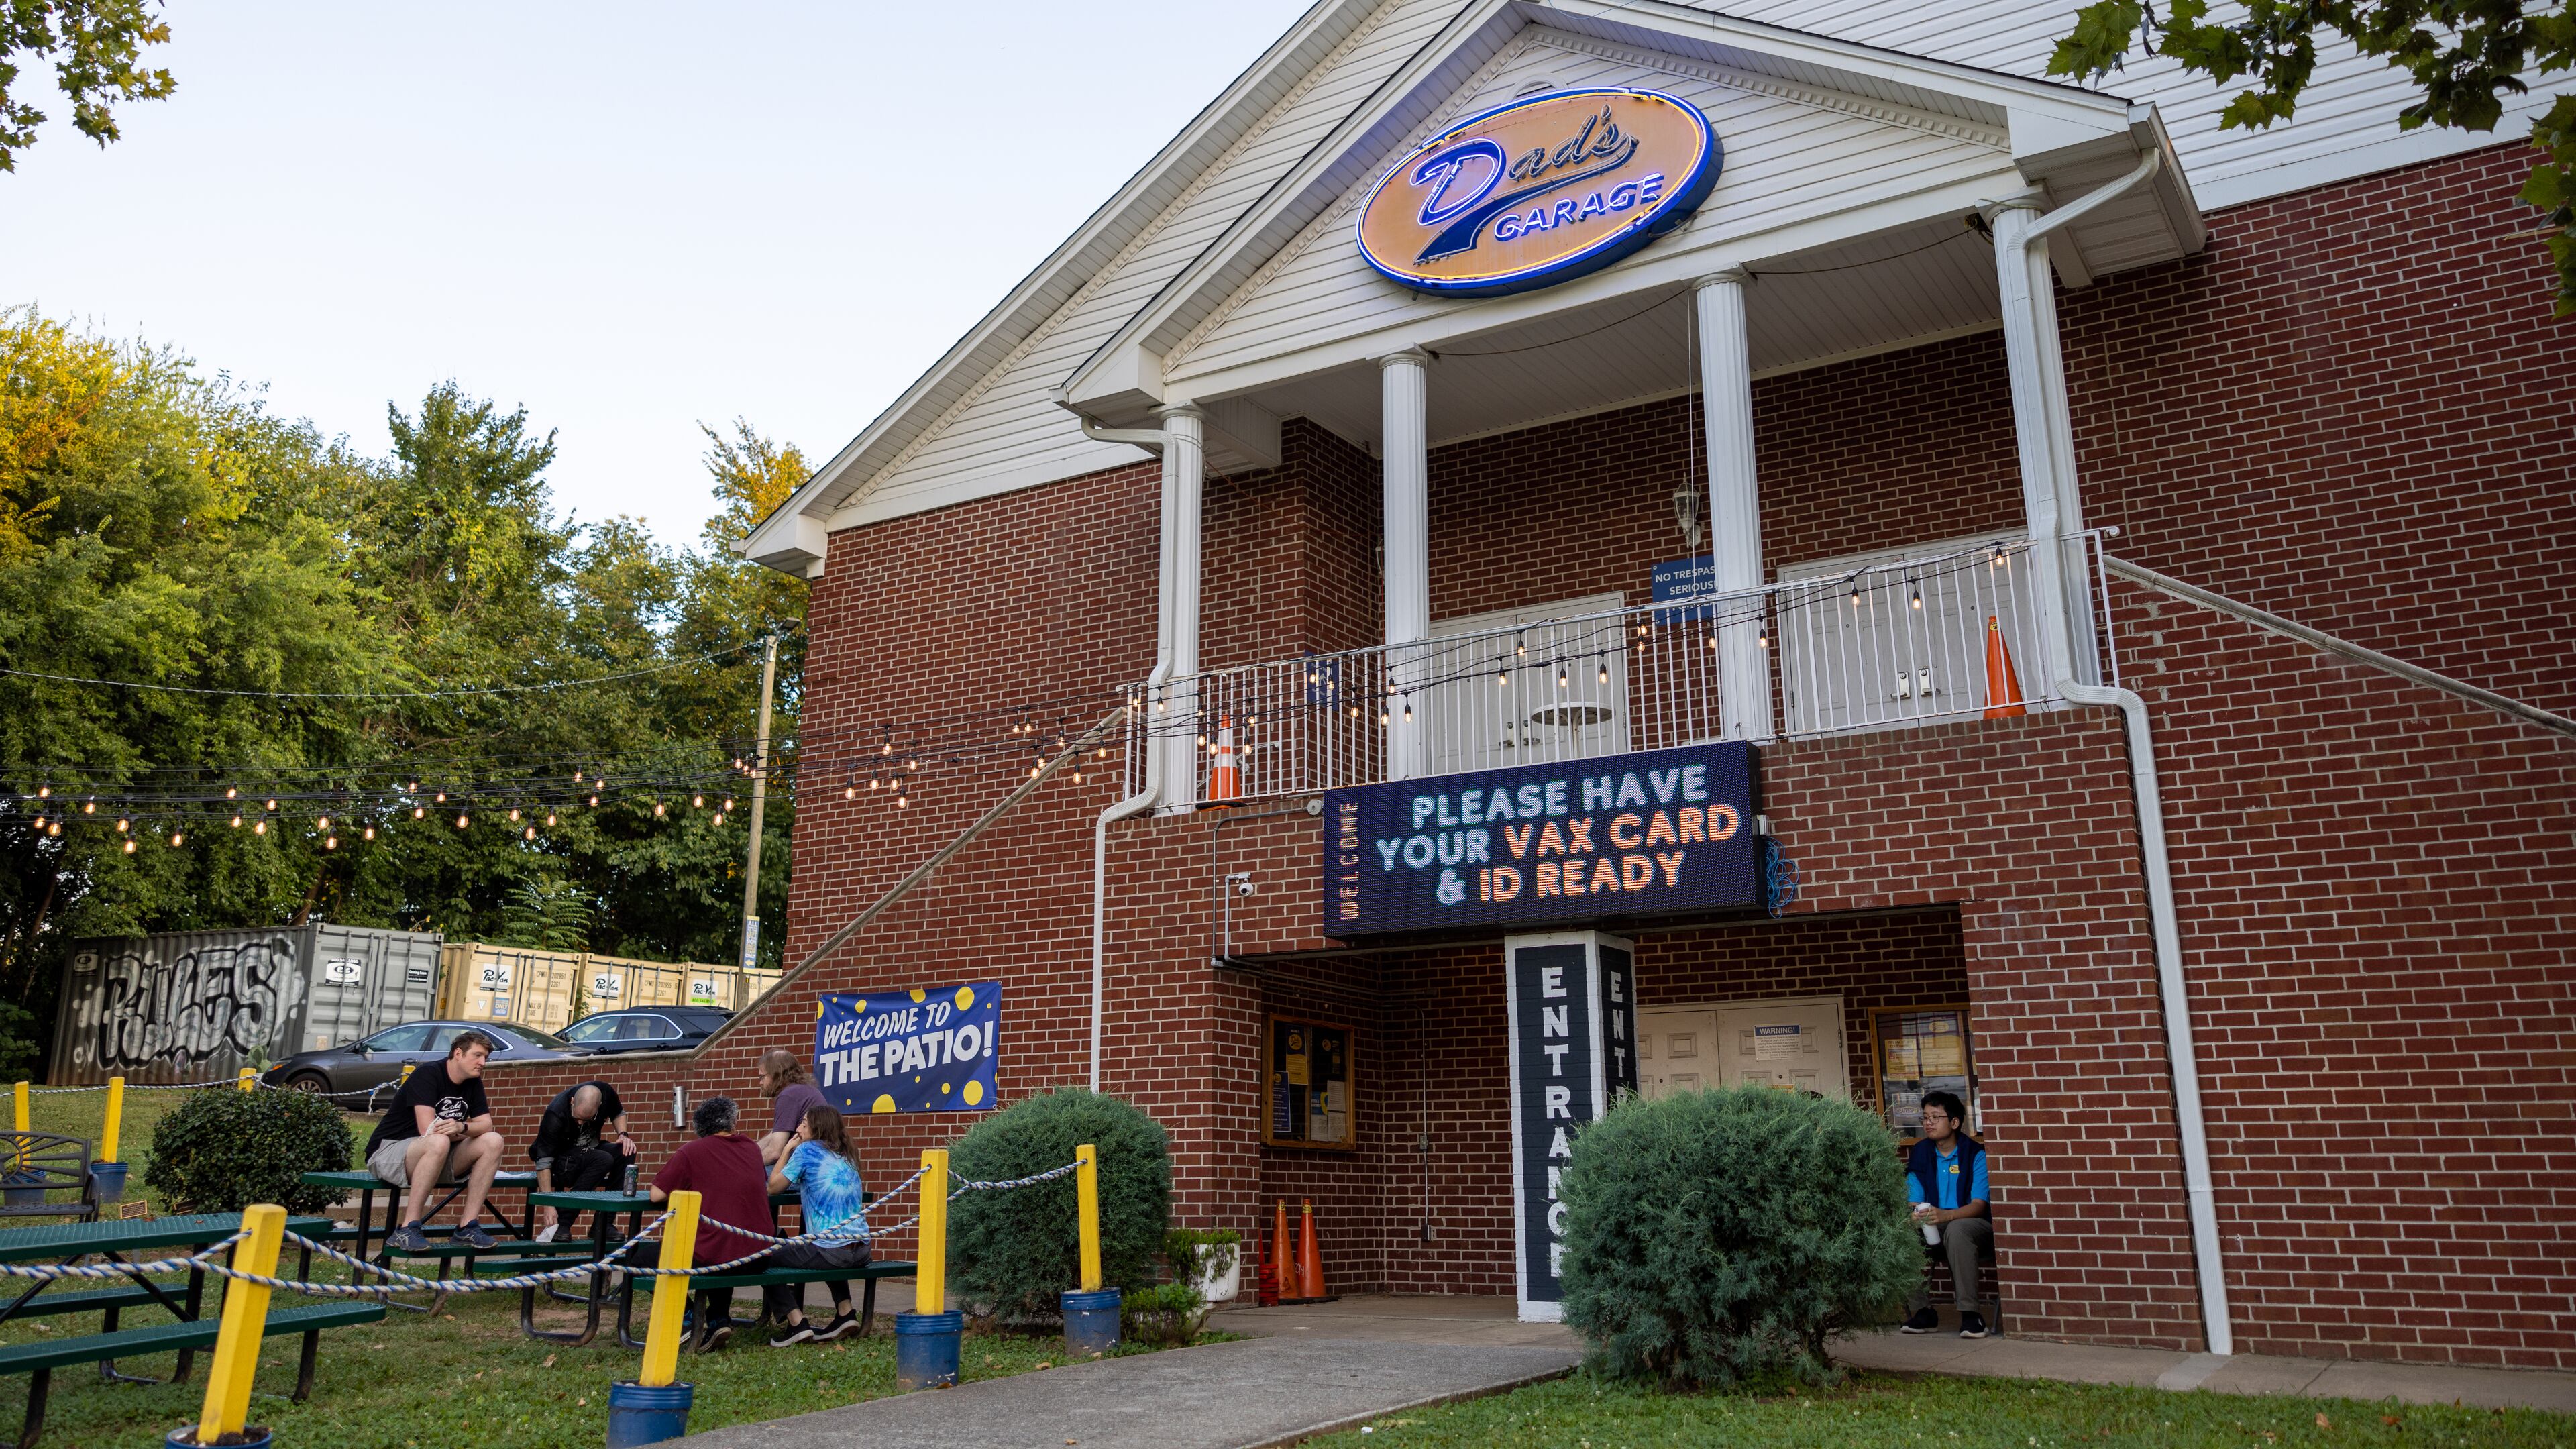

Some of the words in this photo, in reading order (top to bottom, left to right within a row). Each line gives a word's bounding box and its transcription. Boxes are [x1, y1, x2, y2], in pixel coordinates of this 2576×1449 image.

[1409, 103, 1640, 226] Dad's
[1494, 172, 1664, 241] GARAGE
[1655, 573, 1671, 582] NO
[1413, 779, 1567, 830] PLEASE
[1582, 764, 1707, 812] HAVE
[1340, 802, 1360, 920] WELCOME
[1376, 828, 1491, 871] YOUR
[1504, 818, 1595, 859] VAX
[1609, 803, 1740, 849] CARD
[1436, 868, 1466, 905] &
[1480, 866, 1523, 903] ID
[1536, 849, 1686, 898] READY
[820, 1044, 879, 1087] THE
[884, 1020, 994, 1076] PATIO!
[823, 1007, 918, 1049] WELCOME
[926, 1001, 951, 1029] TO
[1759, 1027, 1796, 1035] WARNING!
